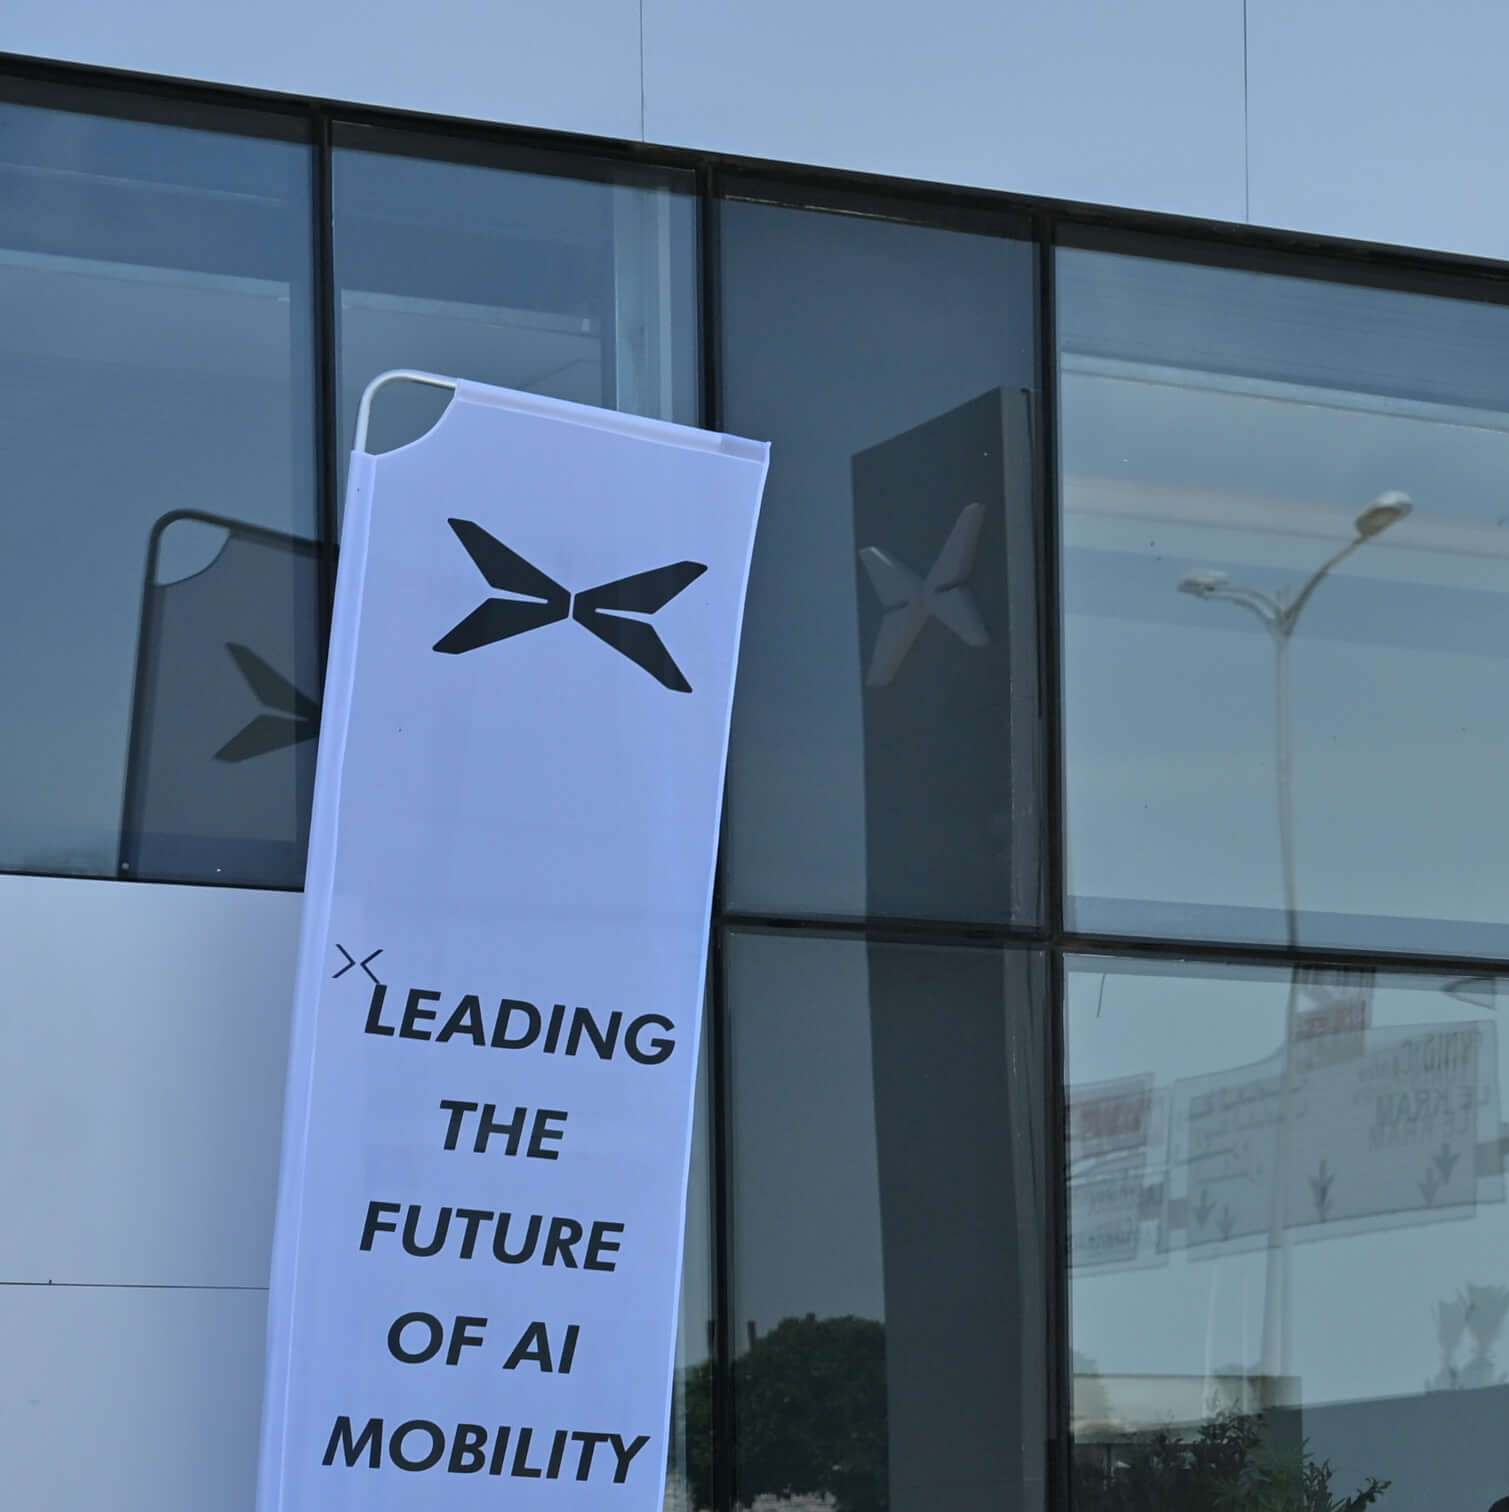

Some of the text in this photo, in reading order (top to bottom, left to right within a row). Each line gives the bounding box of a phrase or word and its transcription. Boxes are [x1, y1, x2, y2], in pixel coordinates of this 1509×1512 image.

[365, 984, 676, 1065] LEADING
[439, 1099, 568, 1160] THE
[359, 1200, 625, 1272] FUTURE
[387, 1311, 580, 1374] OF AI
[321, 1415, 651, 1484] MOBILITY
